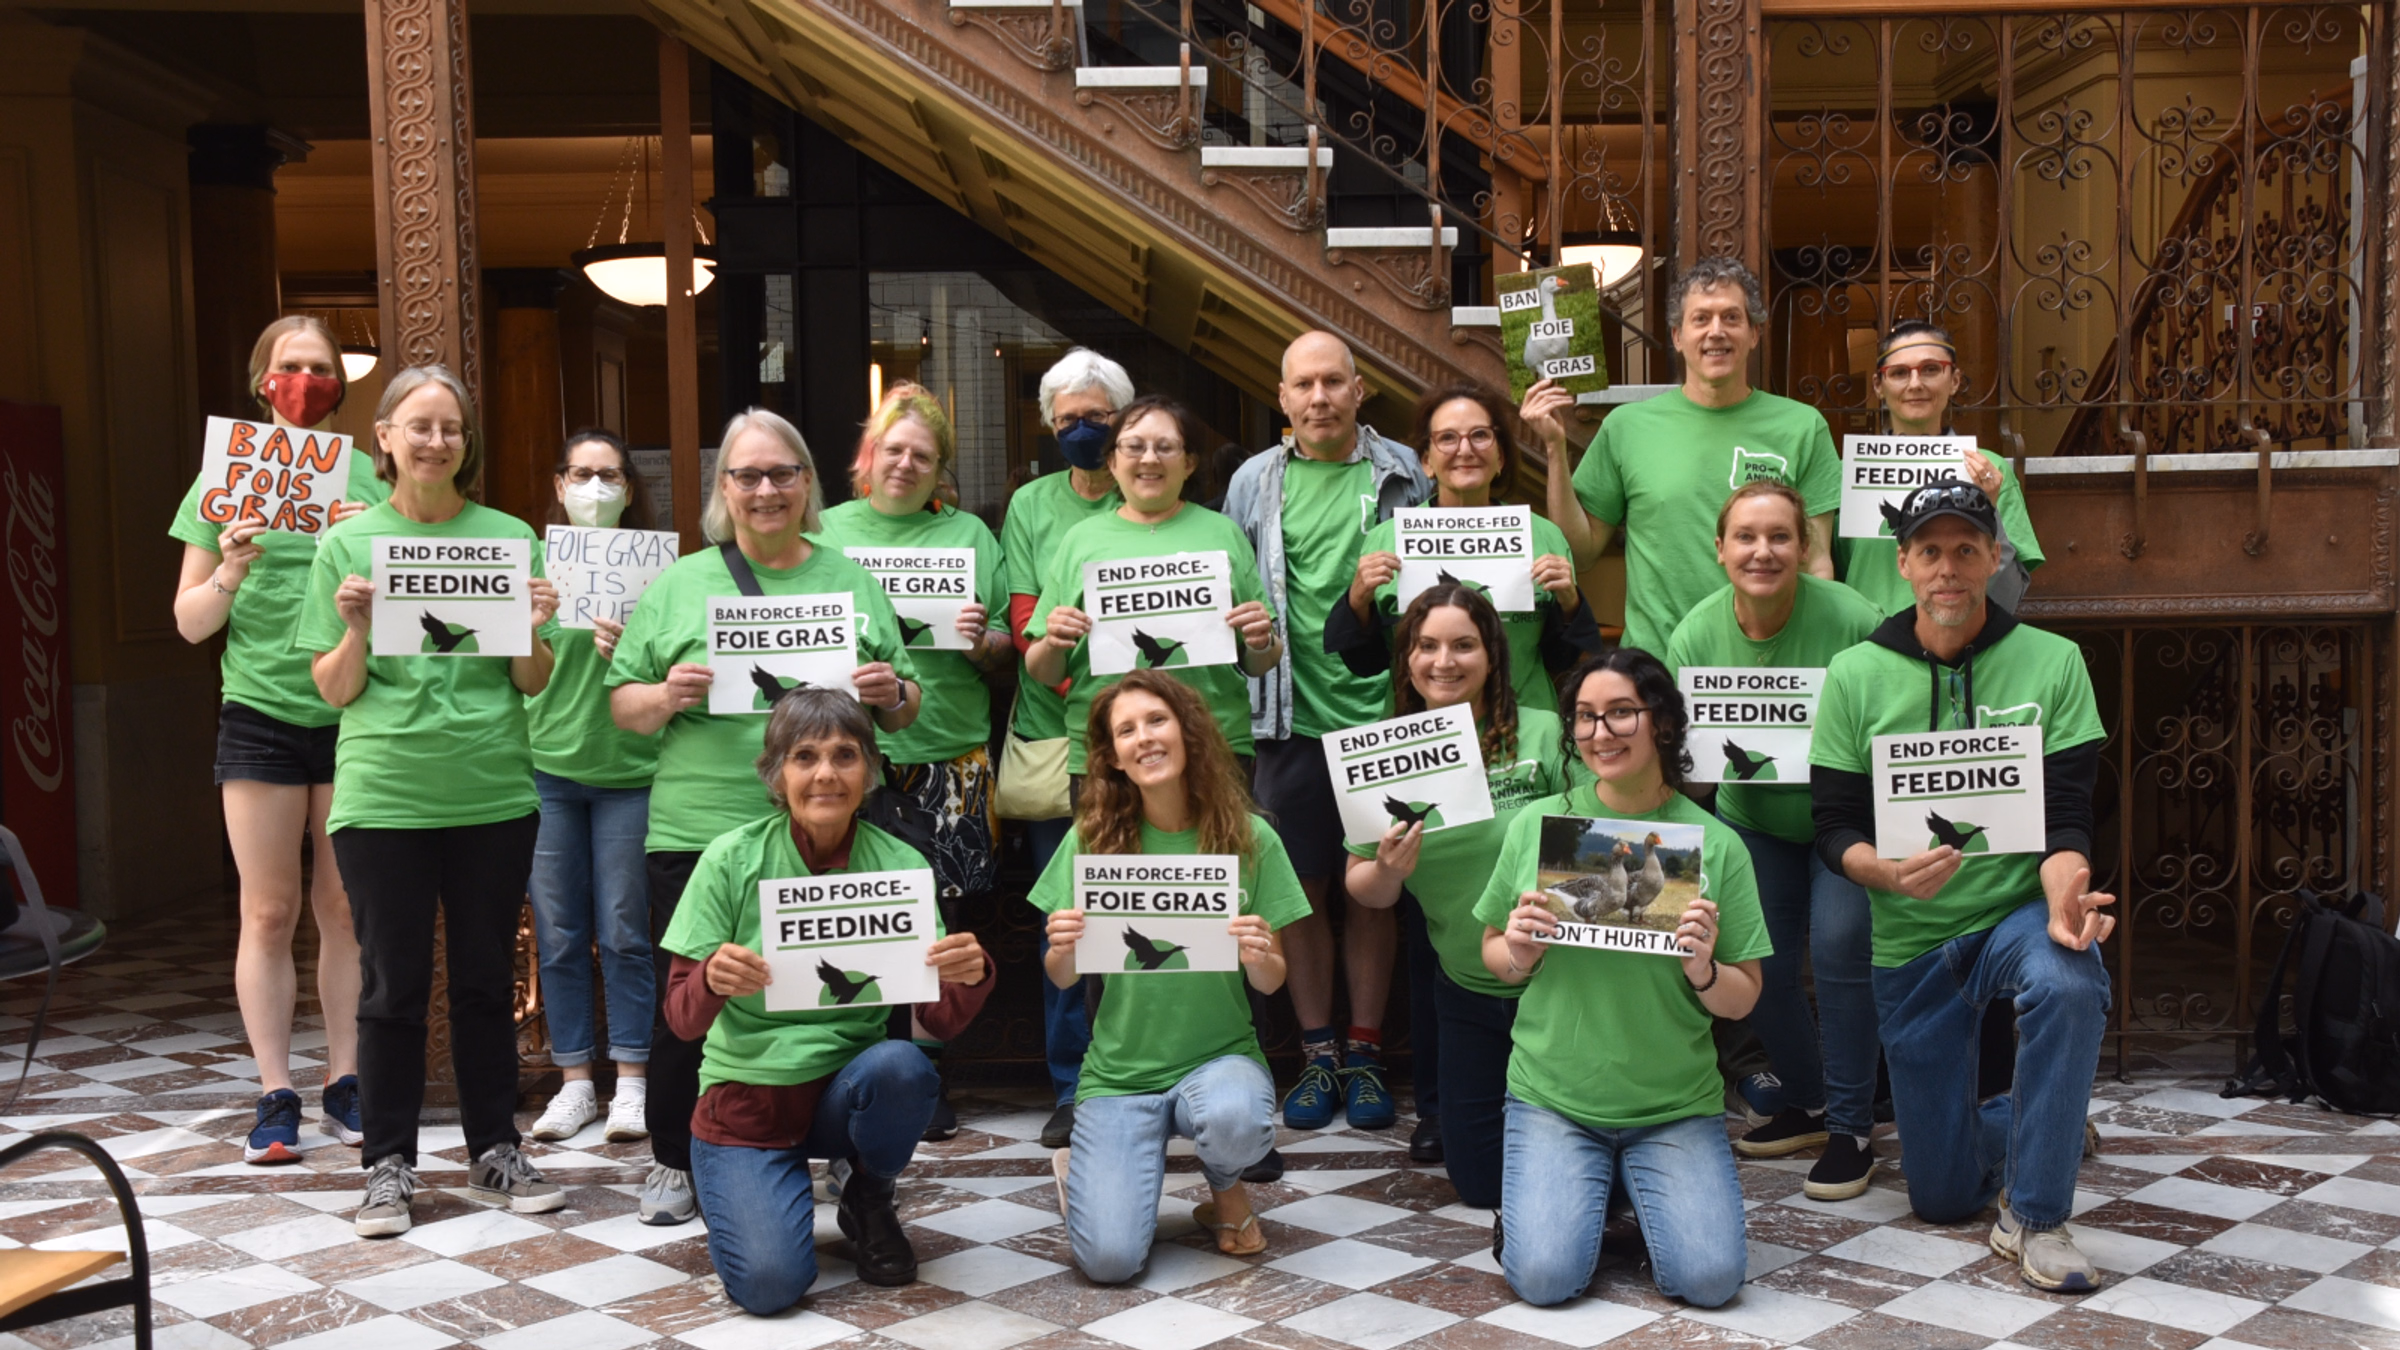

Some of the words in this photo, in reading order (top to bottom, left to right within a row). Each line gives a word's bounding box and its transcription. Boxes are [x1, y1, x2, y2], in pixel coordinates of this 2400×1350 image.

[1503, 290, 1538, 308] BAN
[1534, 320, 1570, 337] FOIE
[1546, 357, 1592, 375] GRAS
[227, 422, 342, 473] BAN
[1856, 443, 1891, 455] END
[1896, 443, 1960, 456] FORCE-
[226, 462, 314, 501] FOIS
[1855, 467, 1958, 485] FEEDING
[1403, 518, 1434, 529] BAN
[1437, 516, 1521, 529] FORCE-FED
[389, 546, 431, 560] END
[436, 546, 511, 561] FORCE-
[546, 529, 600, 565] FOIE
[1404, 538, 1455, 555] FOIE
[1460, 536, 1523, 554] GRAS
[885, 558, 966, 568] FORCE-FED
[1098, 566, 1136, 583] END
[1140, 560, 1210, 578] FORCE-
[389, 574, 511, 594] FEEDING
[586, 571, 626, 595] IS
[906, 577, 966, 594] GRAS
[558, 595, 638, 625] RUE
[1100, 586, 1212, 615] FEEDING
[4, 448, 64, 793] Coca-Cola
[715, 608, 747, 620] BAN
[751, 604, 843, 620] FORCE-FED
[716, 630, 771, 649] FOIE
[776, 626, 845, 647] GRAS
[1694, 675, 1733, 690] END
[1737, 675, 1808, 690] FORCE-
[1694, 704, 1808, 723] FEEDING
[1340, 732, 1380, 753] END
[1383, 717, 1454, 743] FORCE-
[1890, 742, 1934, 758] END
[1940, 736, 2020, 756] FORCE-
[1346, 743, 1461, 786] FEEDING
[1892, 766, 2020, 794] FEEDING
[1490, 785, 1538, 800] ANIMAL
[1085, 868, 1122, 880] BAN
[1126, 868, 1227, 880] FORCE-FED
[778, 886, 824, 904] END
[830, 880, 912, 900] FORCE-
[1085, 891, 1146, 910] FOIE
[1152, 892, 1228, 911] GRAS
[780, 912, 912, 943] FEEDING
[1604, 928, 1660, 949] HURT
